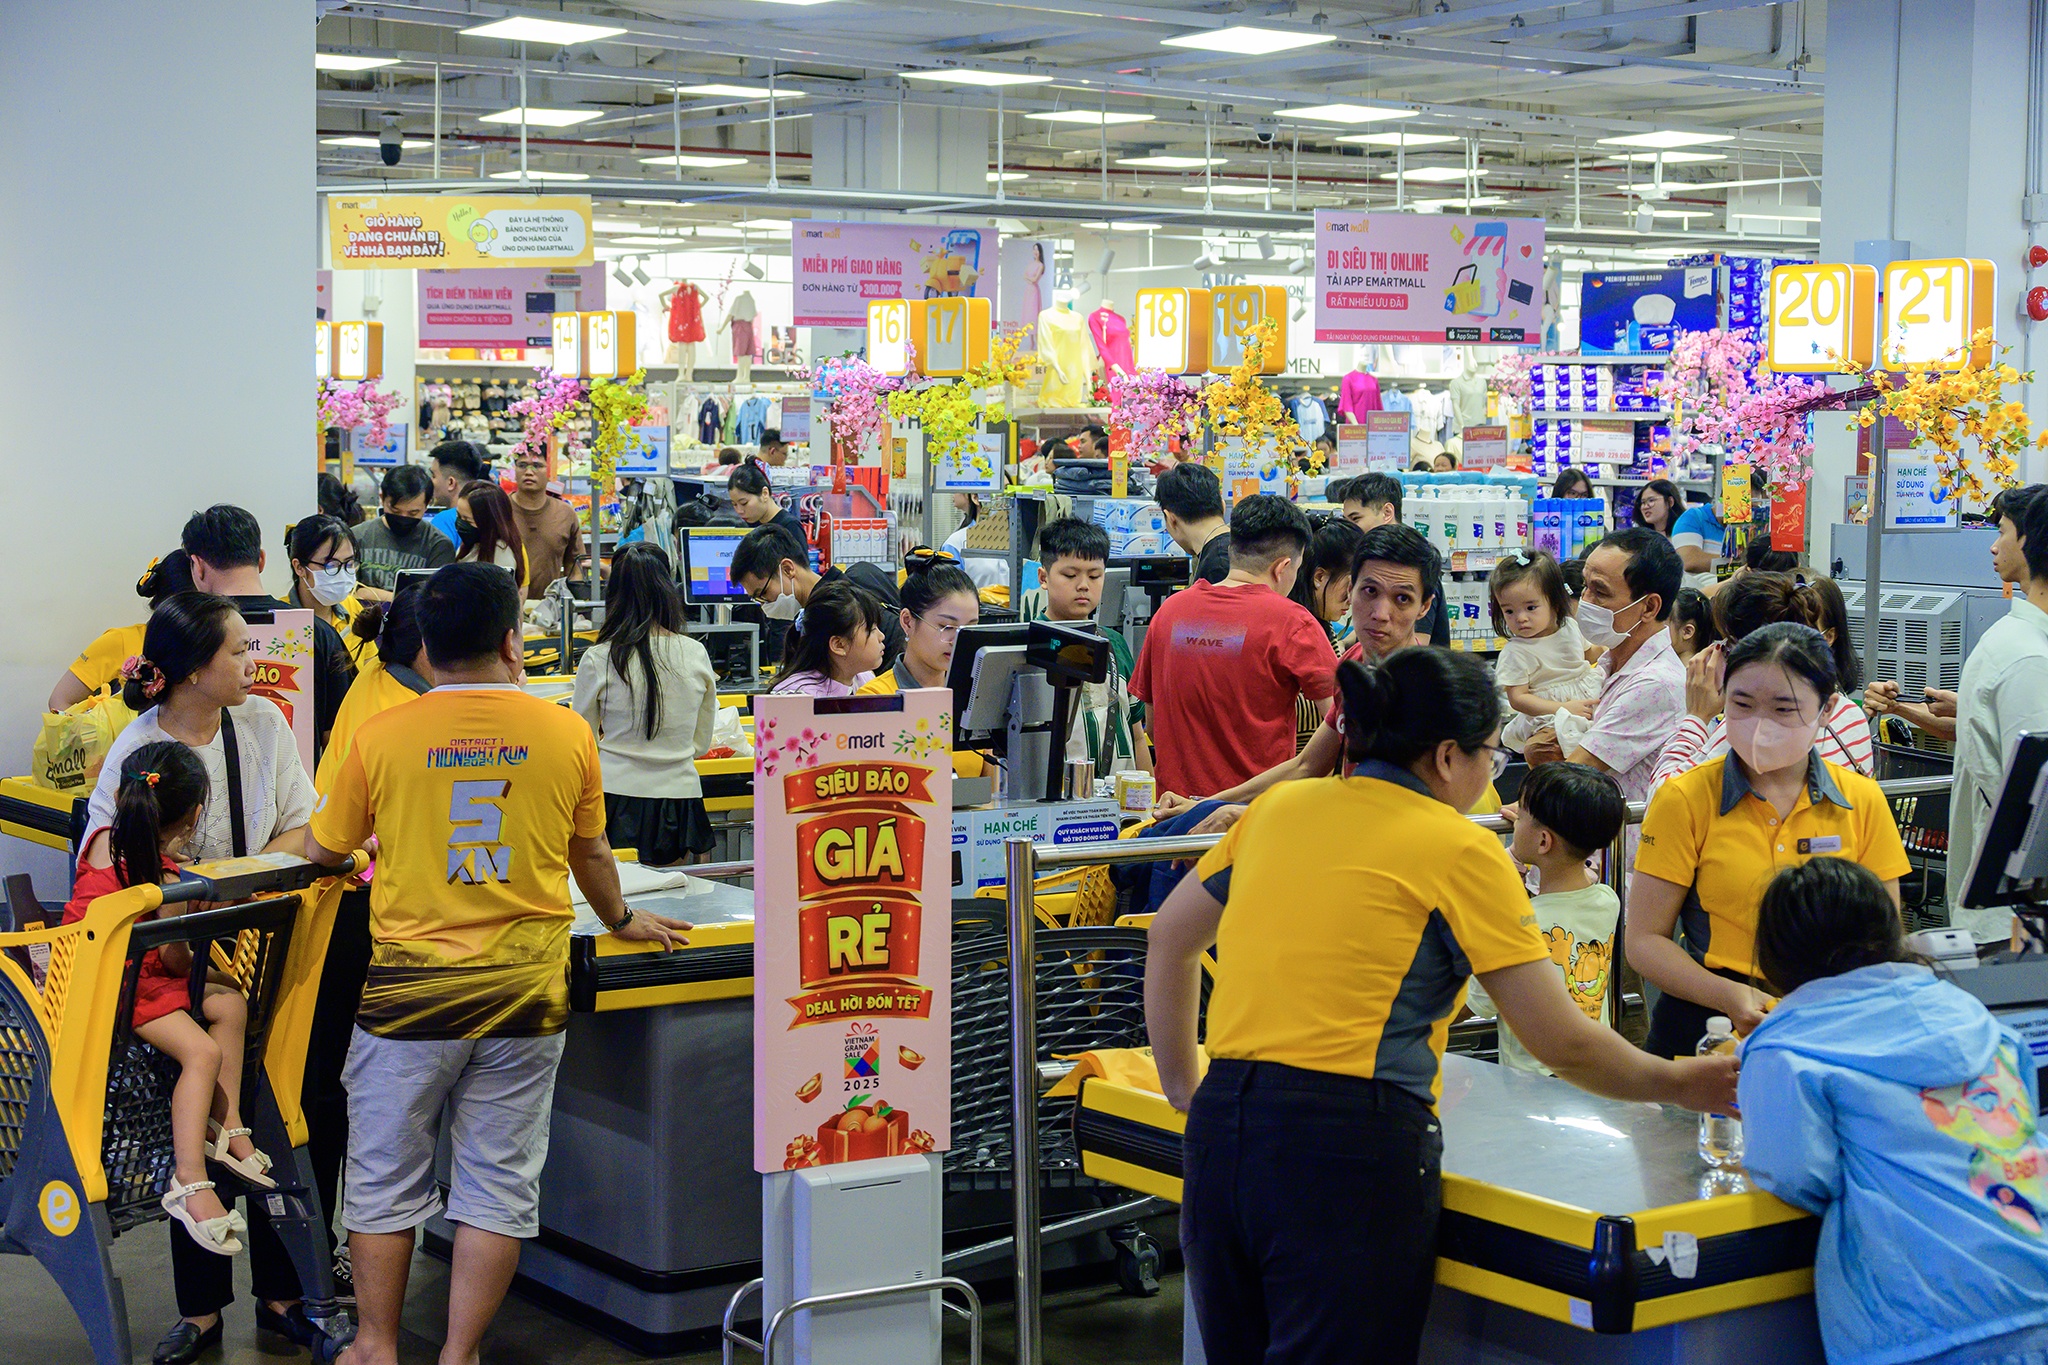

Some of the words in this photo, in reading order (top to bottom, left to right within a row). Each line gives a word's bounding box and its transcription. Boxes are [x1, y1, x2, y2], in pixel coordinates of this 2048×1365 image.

[365, 213, 386, 227] GIỎ
[388, 214, 422, 227] HÀNG
[1326, 221, 1349, 232] emart
[1350, 219, 1370, 233] mall
[349, 231, 383, 242] ĐANG
[384, 228, 426, 242] CHUẨN
[427, 231, 439, 244] BỊ
[528, 234, 547, 242] HÀNG
[801, 229, 823, 238] emart
[359, 243, 386, 256] NHÀ
[386, 246, 412, 259] BẠN
[803, 253, 828, 273] MIỄN
[831, 255, 848, 274] PHÍ
[851, 259, 873, 275] GIAO
[876, 257, 902, 275] HÀNG
[1327, 250, 1339, 269] ĐI
[1342, 246, 1367, 270] SIÊU
[1370, 252, 1387, 274] THỊ
[1391, 252, 1429, 272] ONLINE
[1326, 272, 1342, 285] TẢI
[1344, 277, 1364, 286] APP
[1366, 278, 1426, 288] EMARTMALL
[1605, 275, 1626, 283] PREMIUM
[1688, 275, 1708, 287] Tempo
[802, 283, 820, 292] ĐƠN
[821, 282, 845, 292] HÀNG
[847, 283, 858, 293] TỪ
[1899, 267, 1952, 324] 21
[1331, 293, 1348, 306] RẤT
[1349, 294, 1374, 307] NHIỀU
[1375, 297, 1389, 307] ƯU
[1390, 297, 1404, 308] ĐÃI
[1779, 271, 1841, 327] 20
[1144, 292, 1177, 338] 18
[1217, 292, 1254, 337] 19
[874, 304, 901, 344] 16
[930, 303, 959, 344] 17
[556, 317, 573, 350] 14
[593, 315, 610, 350] 15
[1648, 332, 1668, 345] Tempo
[1897, 468, 1913, 477] HẠN
[1913, 465, 1928, 477] CHẾ
[1905, 480, 1925, 490] DỤNG
[1186, 636, 1224, 648] WAVE
[251, 665, 281, 684] ÃO
[450, 738, 498, 746] DISTRICT
[835, 732, 886, 750] emart
[463, 758, 494, 767] 2024
[498, 745, 529, 766] RUN
[815, 768, 860, 798] SIÊU
[865, 766, 910, 794] BÃO
[448, 779, 513, 848] 5
[984, 821, 1010, 836] HẠN
[1013, 813, 1039, 832] CHẾ
[1070, 827, 1090, 835] KHÁCH
[813, 817, 905, 882] GIÁ
[985, 838, 1001, 846] DỤNG
[447, 846, 516, 885] KM
[827, 903, 892, 970] RẺ
[805, 1001, 837, 1017] DEAL
[840, 994, 863, 1012] HỜI
[866, 994, 892, 1011] ĐÓN
[896, 994, 921, 1012] TẾT
[844, 1036, 875, 1045] VIETNAM
[844, 1044, 869, 1052] GRAND
[844, 1051, 861, 1059] SALE
[844, 1078, 880, 1092] 2025
[47, 1188, 72, 1228] e
